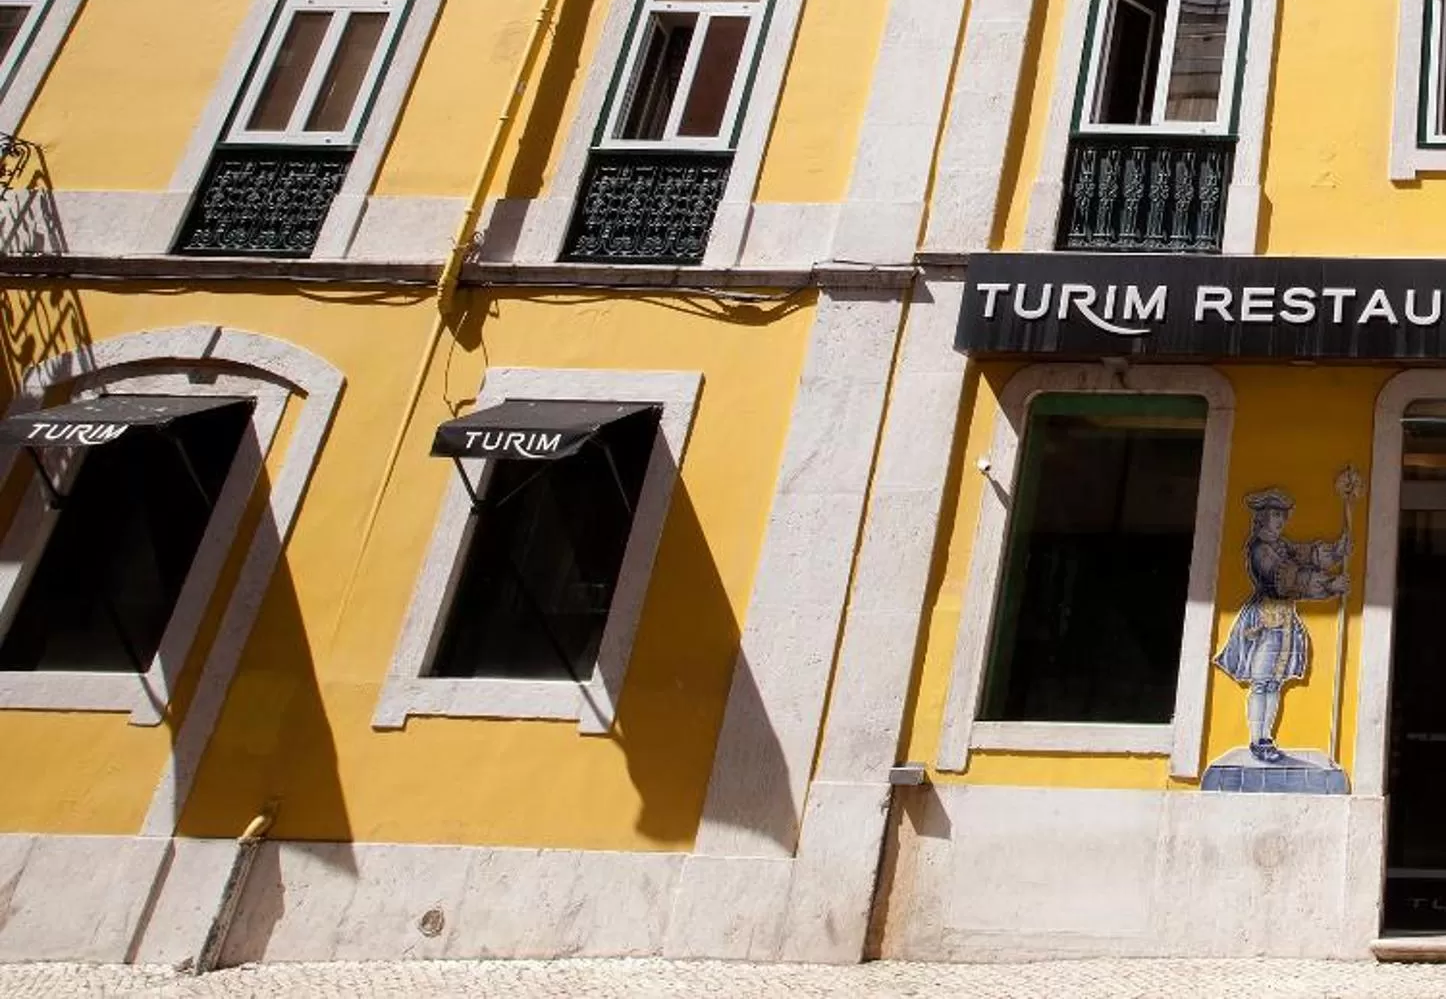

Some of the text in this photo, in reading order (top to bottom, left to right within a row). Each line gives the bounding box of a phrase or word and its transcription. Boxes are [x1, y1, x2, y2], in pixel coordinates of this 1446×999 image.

[977, 283, 1167, 335] TURIM
[27, 423, 129, 445] TURIM
[465, 431, 562, 458] TURIM
